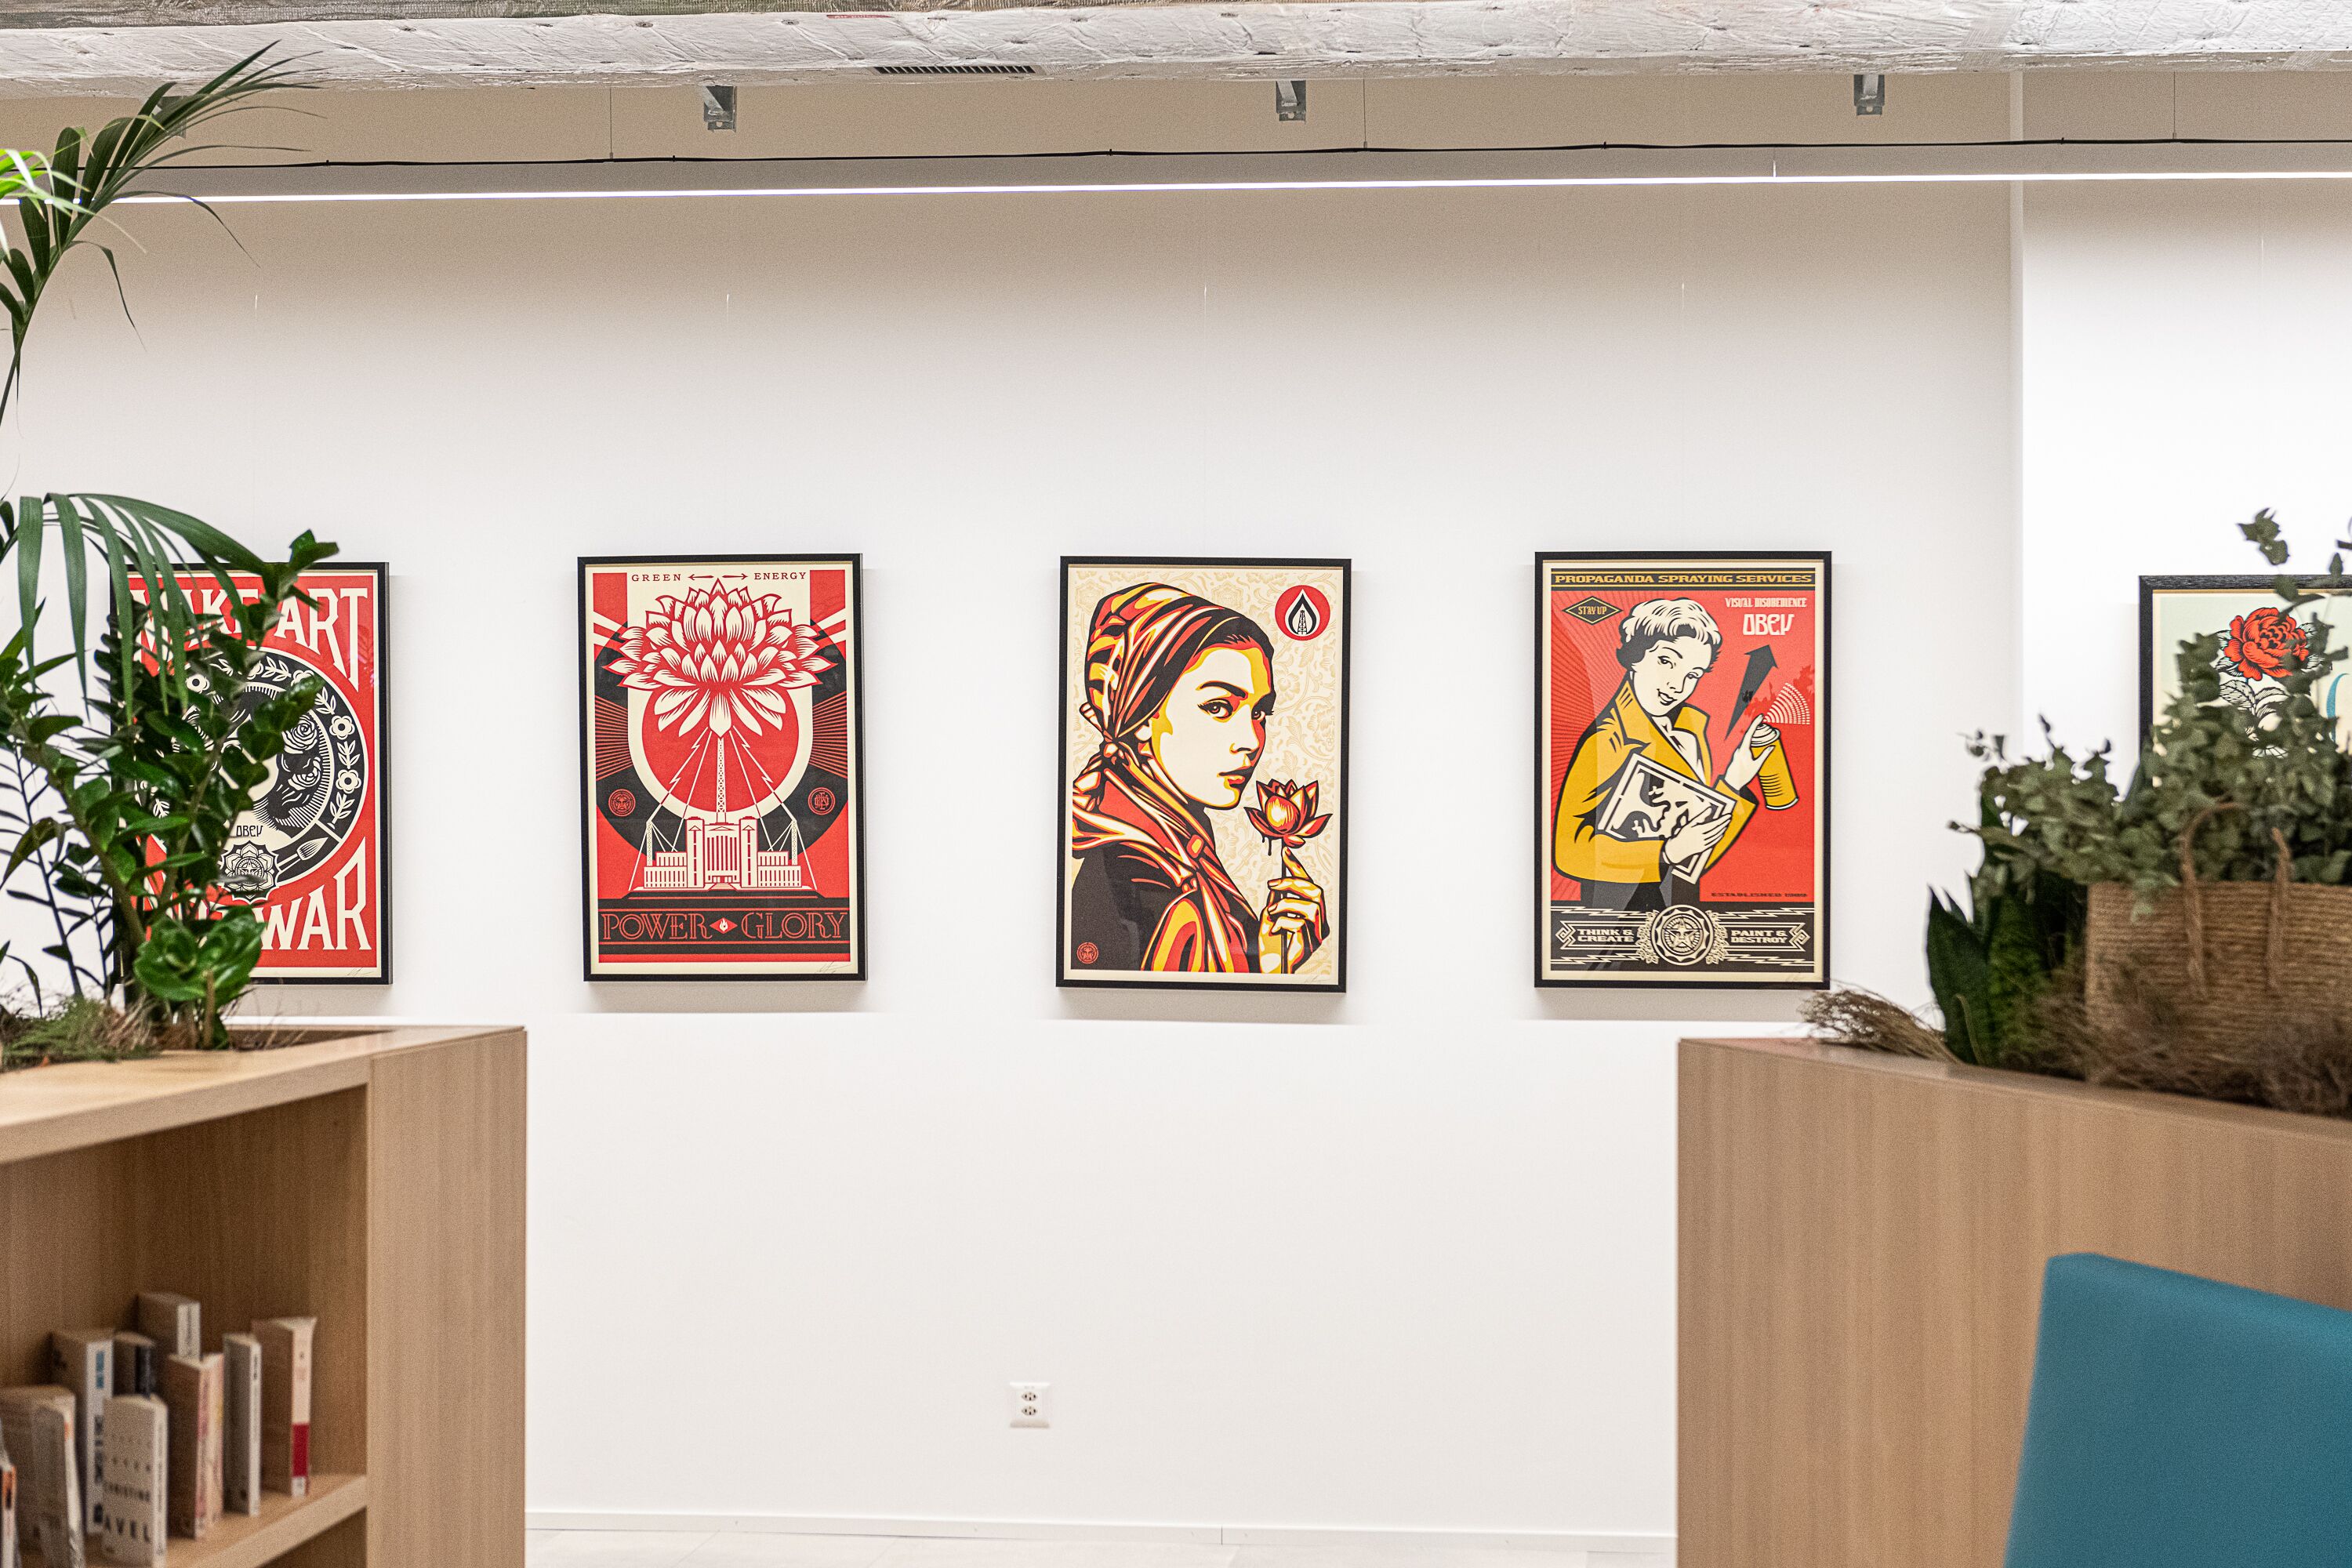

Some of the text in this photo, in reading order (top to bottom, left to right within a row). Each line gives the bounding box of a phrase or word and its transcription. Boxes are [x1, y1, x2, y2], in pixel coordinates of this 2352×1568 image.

[754, 572, 806, 580] ENERGY
[1657, 575, 1733, 583] SPRAYING
[1725, 597, 1807, 607] VISUAL DISOBEDIENCE
[1578, 606, 1607, 615] STAY UP
[1743, 614, 1795, 635] OBEY
[274, 588, 368, 692] ART
[236, 825, 263, 837] OBEY
[252, 837, 372, 950] WAR
[601, 912, 848, 940] POWER GLORY
